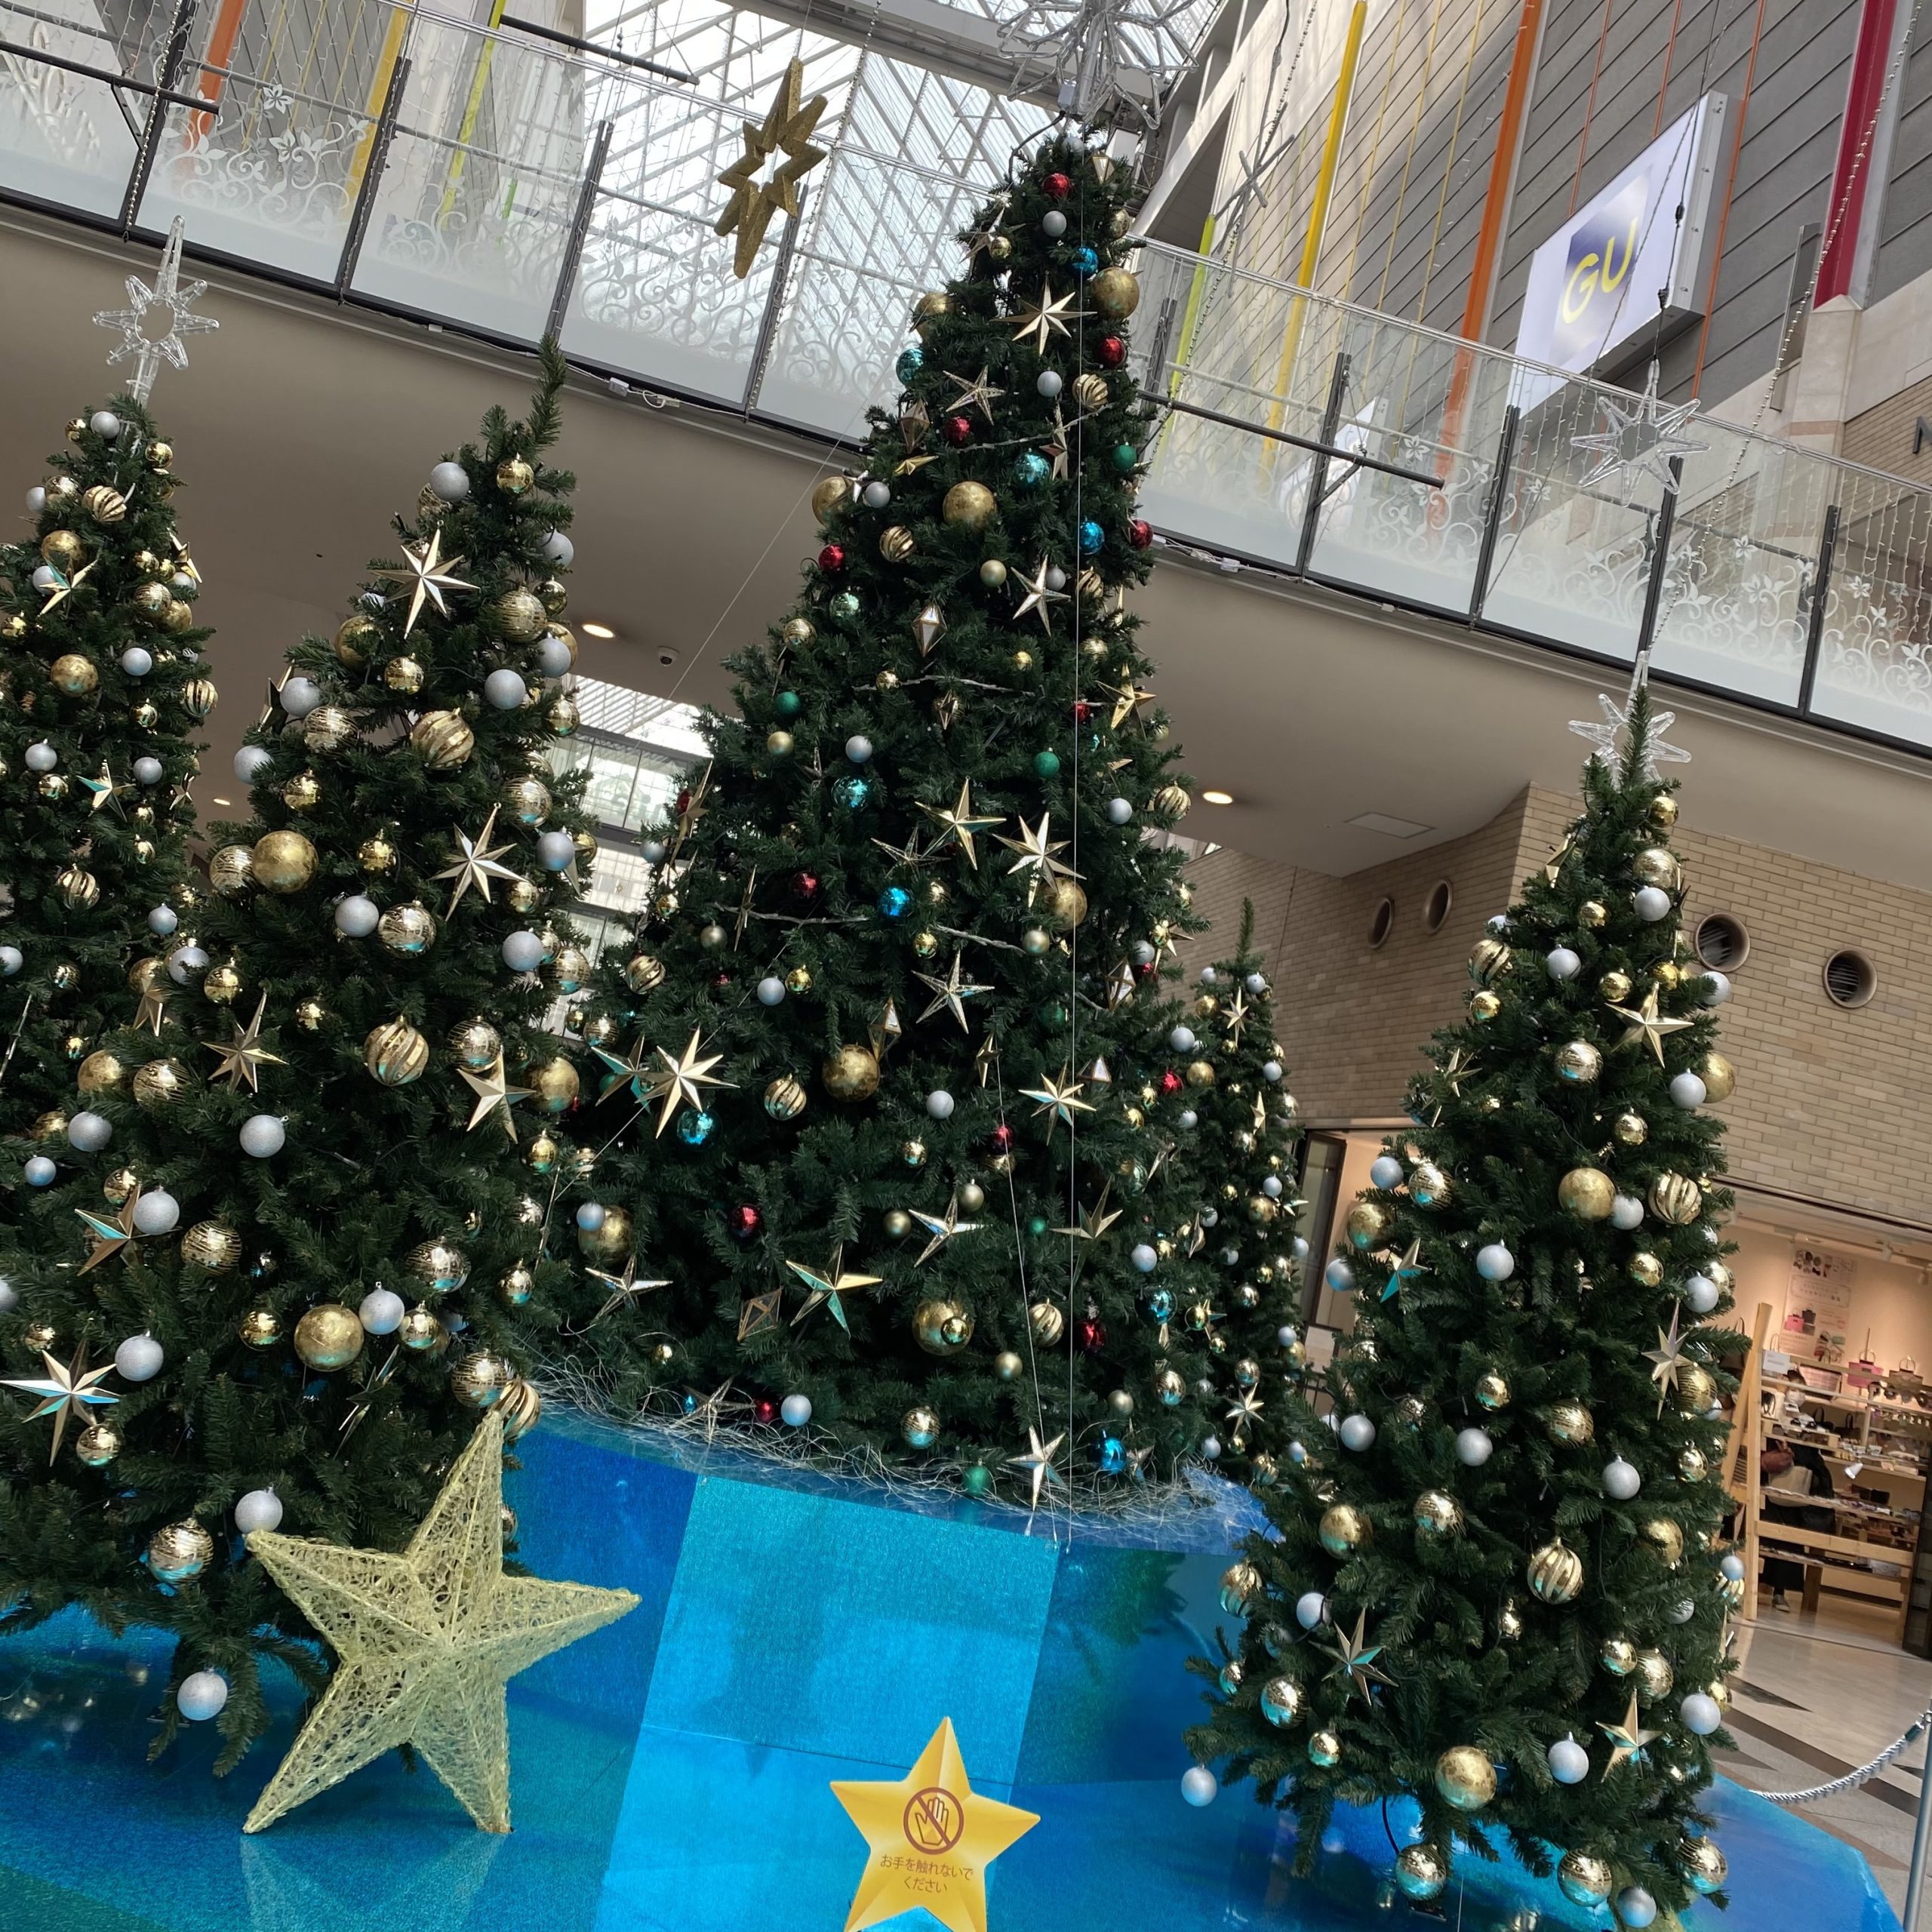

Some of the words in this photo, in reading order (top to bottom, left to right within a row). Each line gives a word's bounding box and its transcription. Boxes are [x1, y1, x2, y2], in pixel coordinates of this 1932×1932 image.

[1563, 217, 1638, 324] GU
[880, 1855, 974, 1881] お手を触れないで
[904, 1876, 947, 1893] ください
